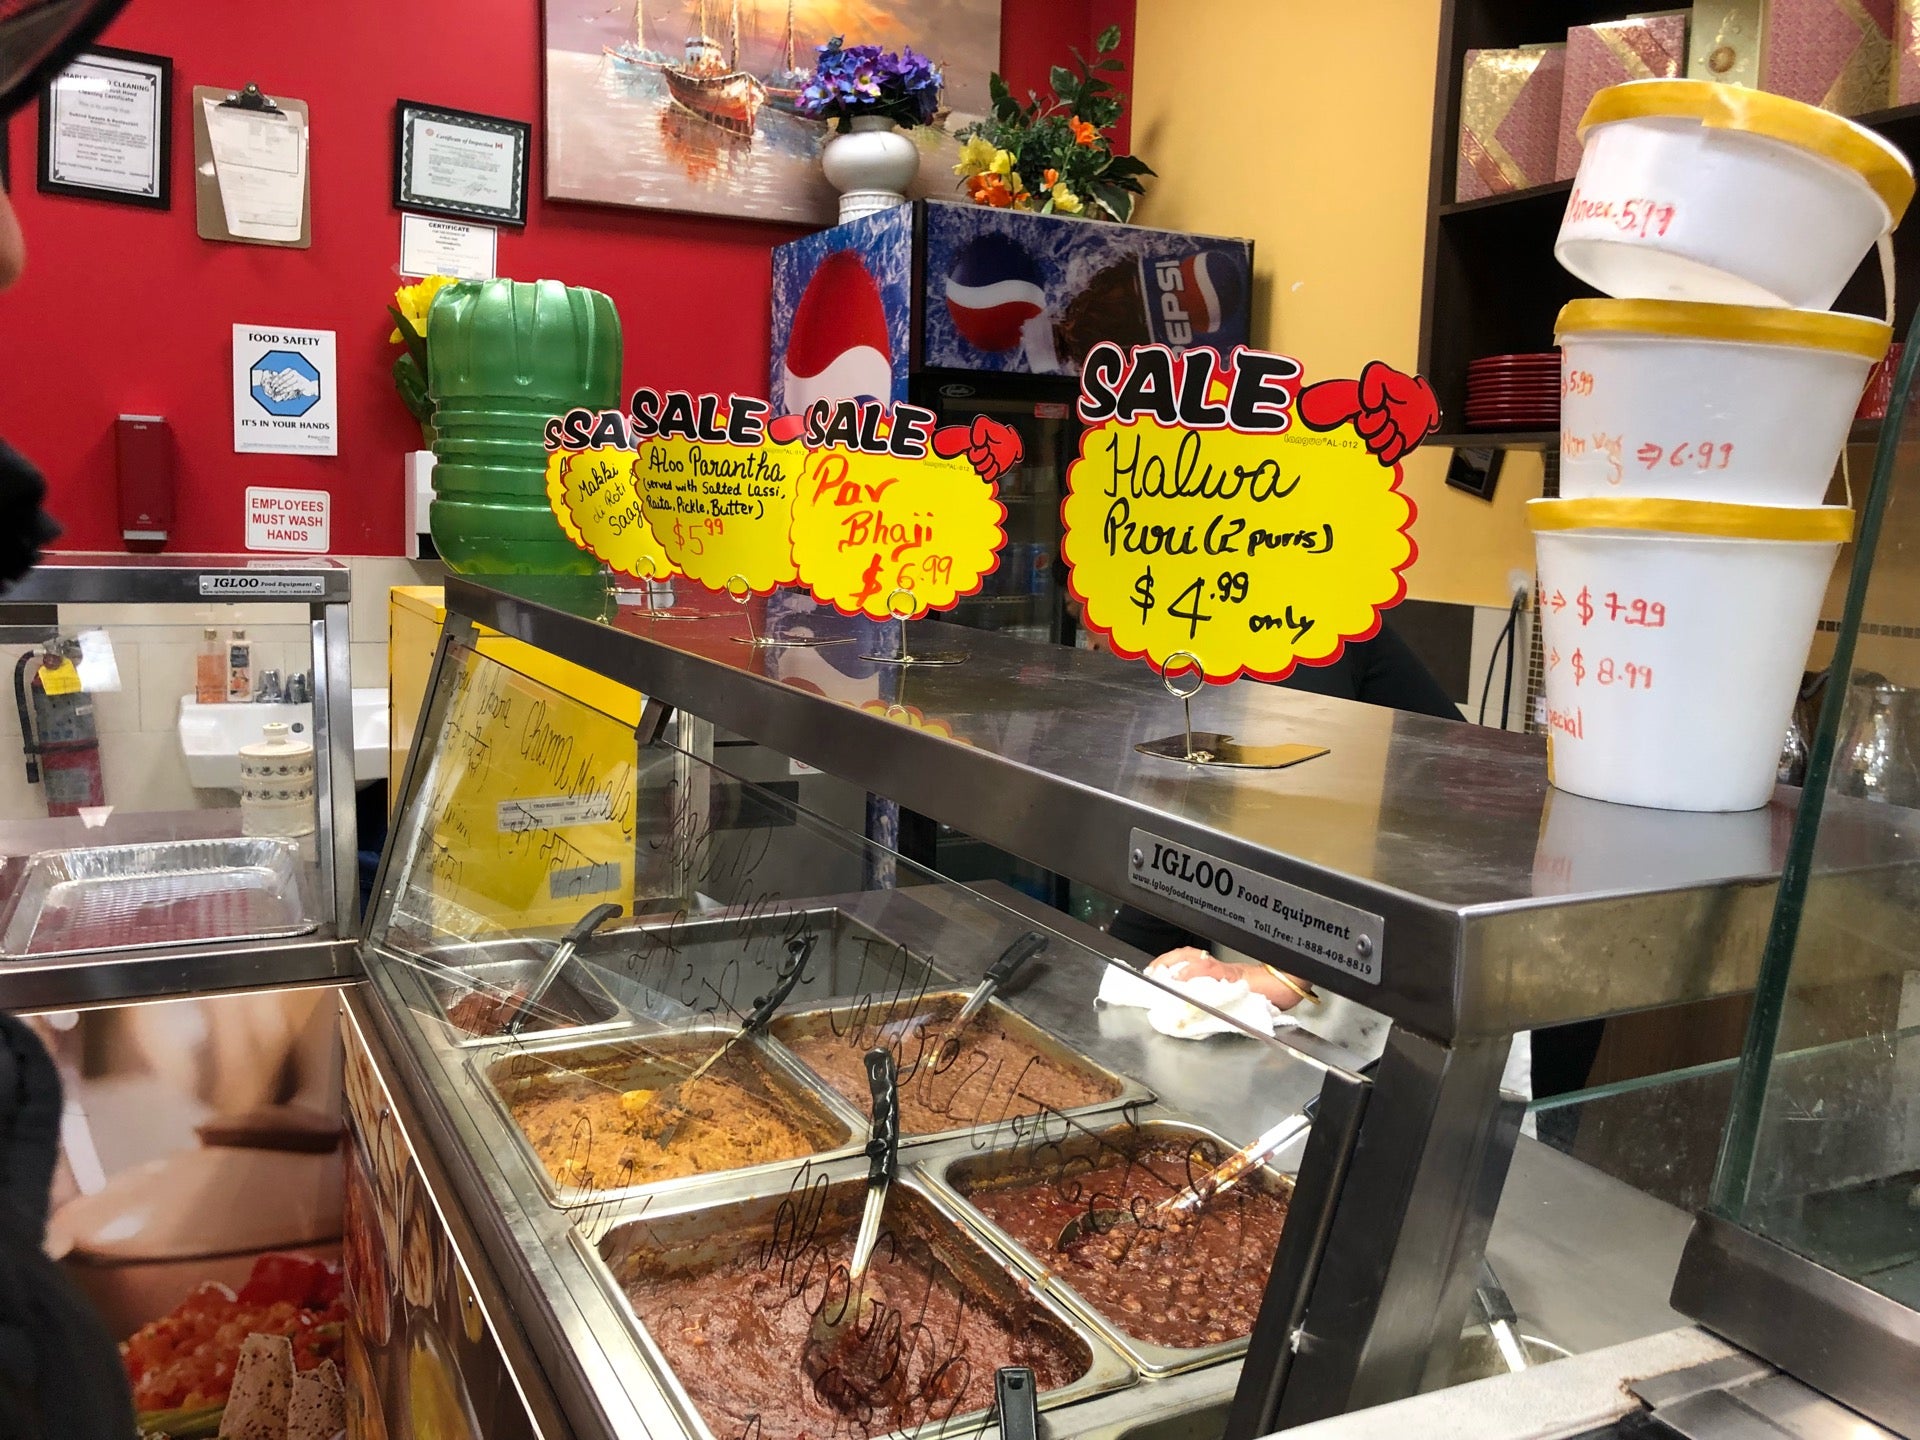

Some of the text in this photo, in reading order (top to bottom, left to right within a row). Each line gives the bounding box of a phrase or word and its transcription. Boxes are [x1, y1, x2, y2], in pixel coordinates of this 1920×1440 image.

[114, 80, 150, 92] CLEANING
[428, 222, 470, 233] CERTIFICATE
[248, 333, 320, 346] FOOD SAFETY
[1079, 345, 1301, 431] SALE
[241, 419, 257, 427] IT'S
[272, 420, 297, 429] YOUR
[299, 421, 330, 430] HANDS
[631, 389, 768, 445] SALE
[806, 398, 934, 457] SALE
[578, 460, 619, 503] Makki
[648, 445, 786, 482] Aloo Parantha
[1104, 430, 1301, 502] Halwa
[252, 498, 324, 512] EMPLOYEES
[675, 479, 698, 492] with
[702, 482, 742, 496] Salted
[252, 513, 323, 527] MUST WASH
[267, 529, 309, 542] HANDS
[608, 501, 643, 536] Saag
[838, 509, 934, 563] Bhaji
[1103, 496, 1198, 556] Puri
[213, 578, 259, 588] IGLOO
[1249, 605, 1315, 644] only
[1597, 657, 1653, 690] 8.99
[1151, 843, 1351, 941] IGLOO Food Equipment
[1132, 873, 1373, 976] www.igloofoodequipment.com Toll free: 1-888-408-8819
